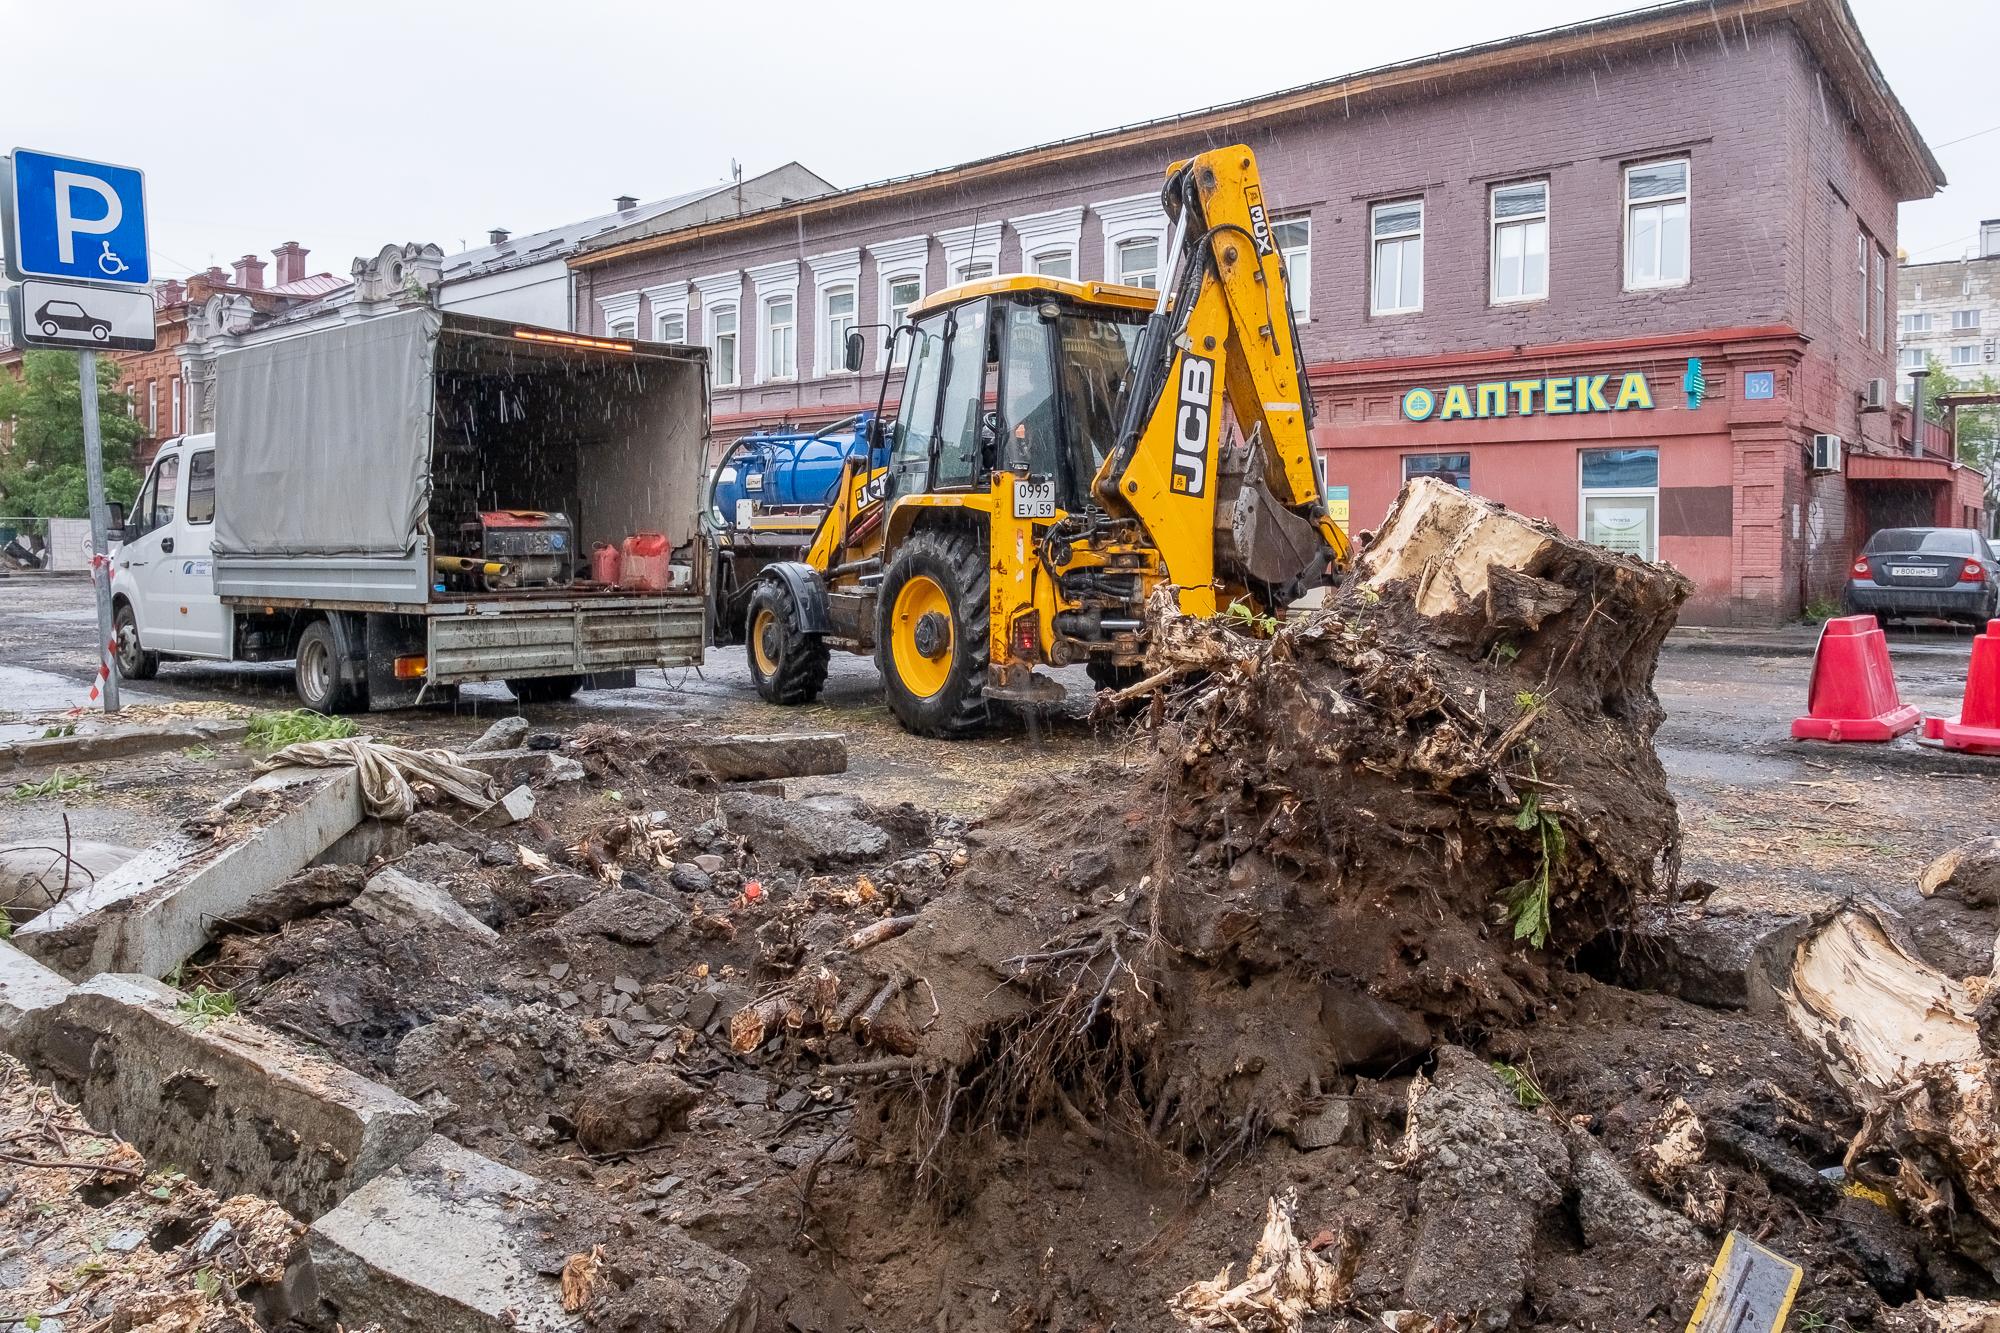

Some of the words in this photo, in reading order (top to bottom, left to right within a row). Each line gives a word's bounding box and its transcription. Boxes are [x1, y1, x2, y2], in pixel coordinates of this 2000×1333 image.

[54, 170, 123, 264] P
[1250, 205, 1273, 254] 3CX
[1440, 372, 1655, 420] АПТЕКА
[1751, 379, 1769, 393] 52
[1174, 357, 1212, 494] JCB
[1019, 484, 1050, 498] 0999
[1039, 504, 1051, 515] 59
